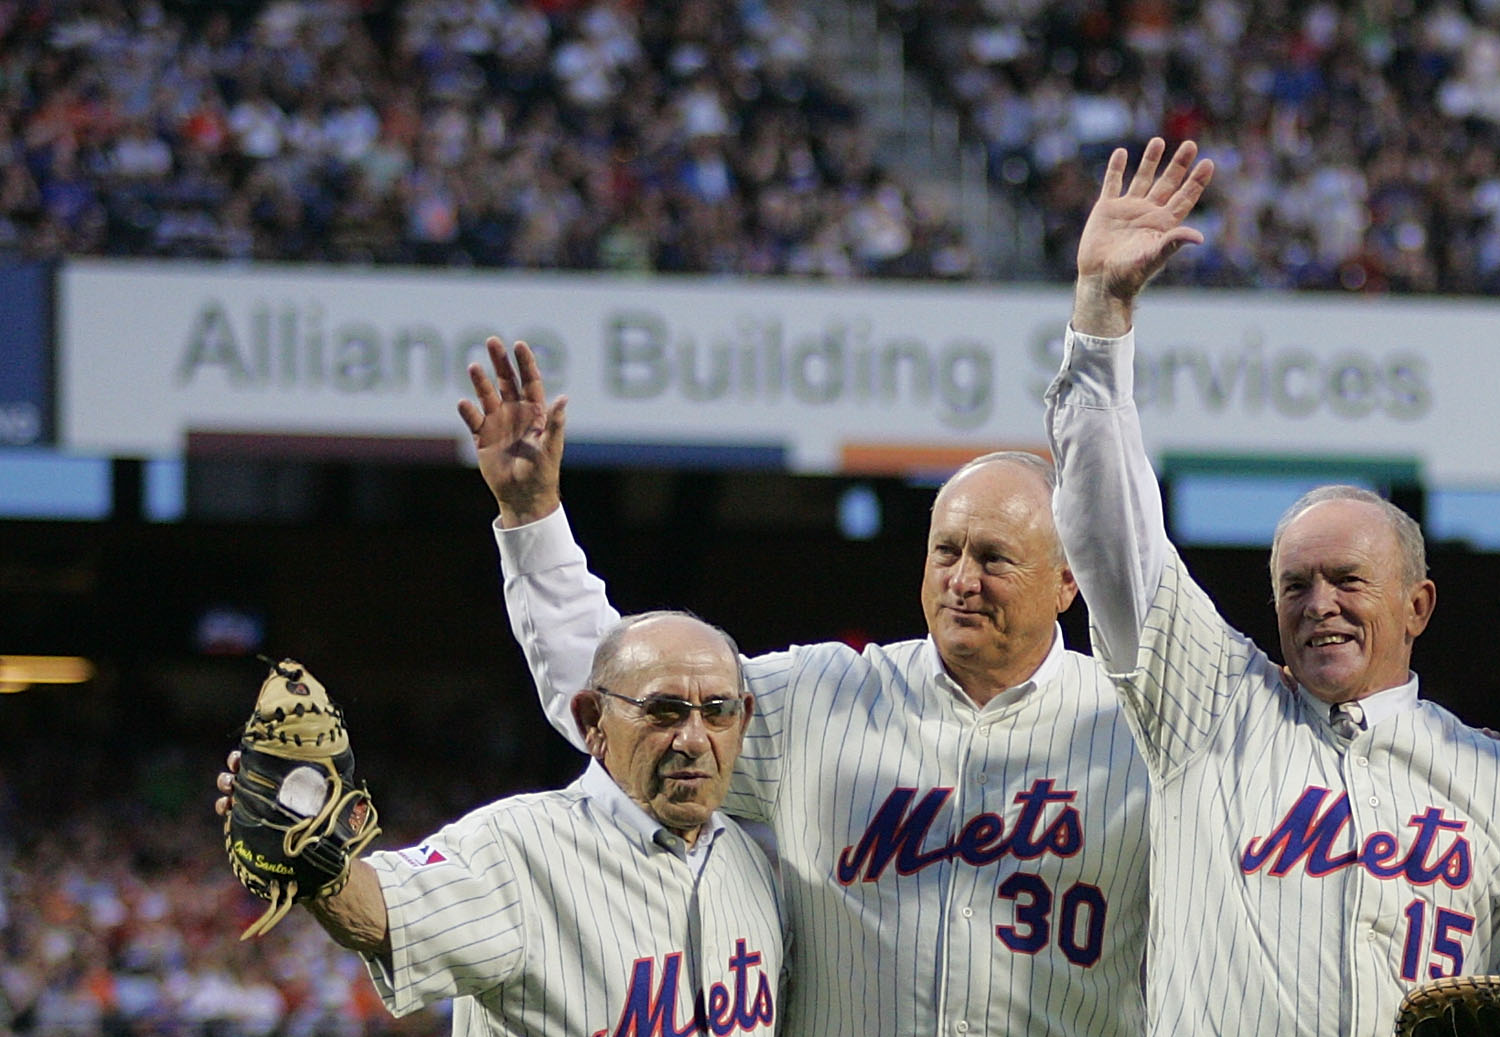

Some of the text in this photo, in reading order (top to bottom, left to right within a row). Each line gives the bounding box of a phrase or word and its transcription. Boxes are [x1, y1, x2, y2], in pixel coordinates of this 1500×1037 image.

[606, 310, 994, 428] Building
[837, 779, 1084, 886] Mets
[1240, 785, 1473, 890] Mets
[995, 872, 1108, 969] 30
[1401, 898, 1477, 983] 15
